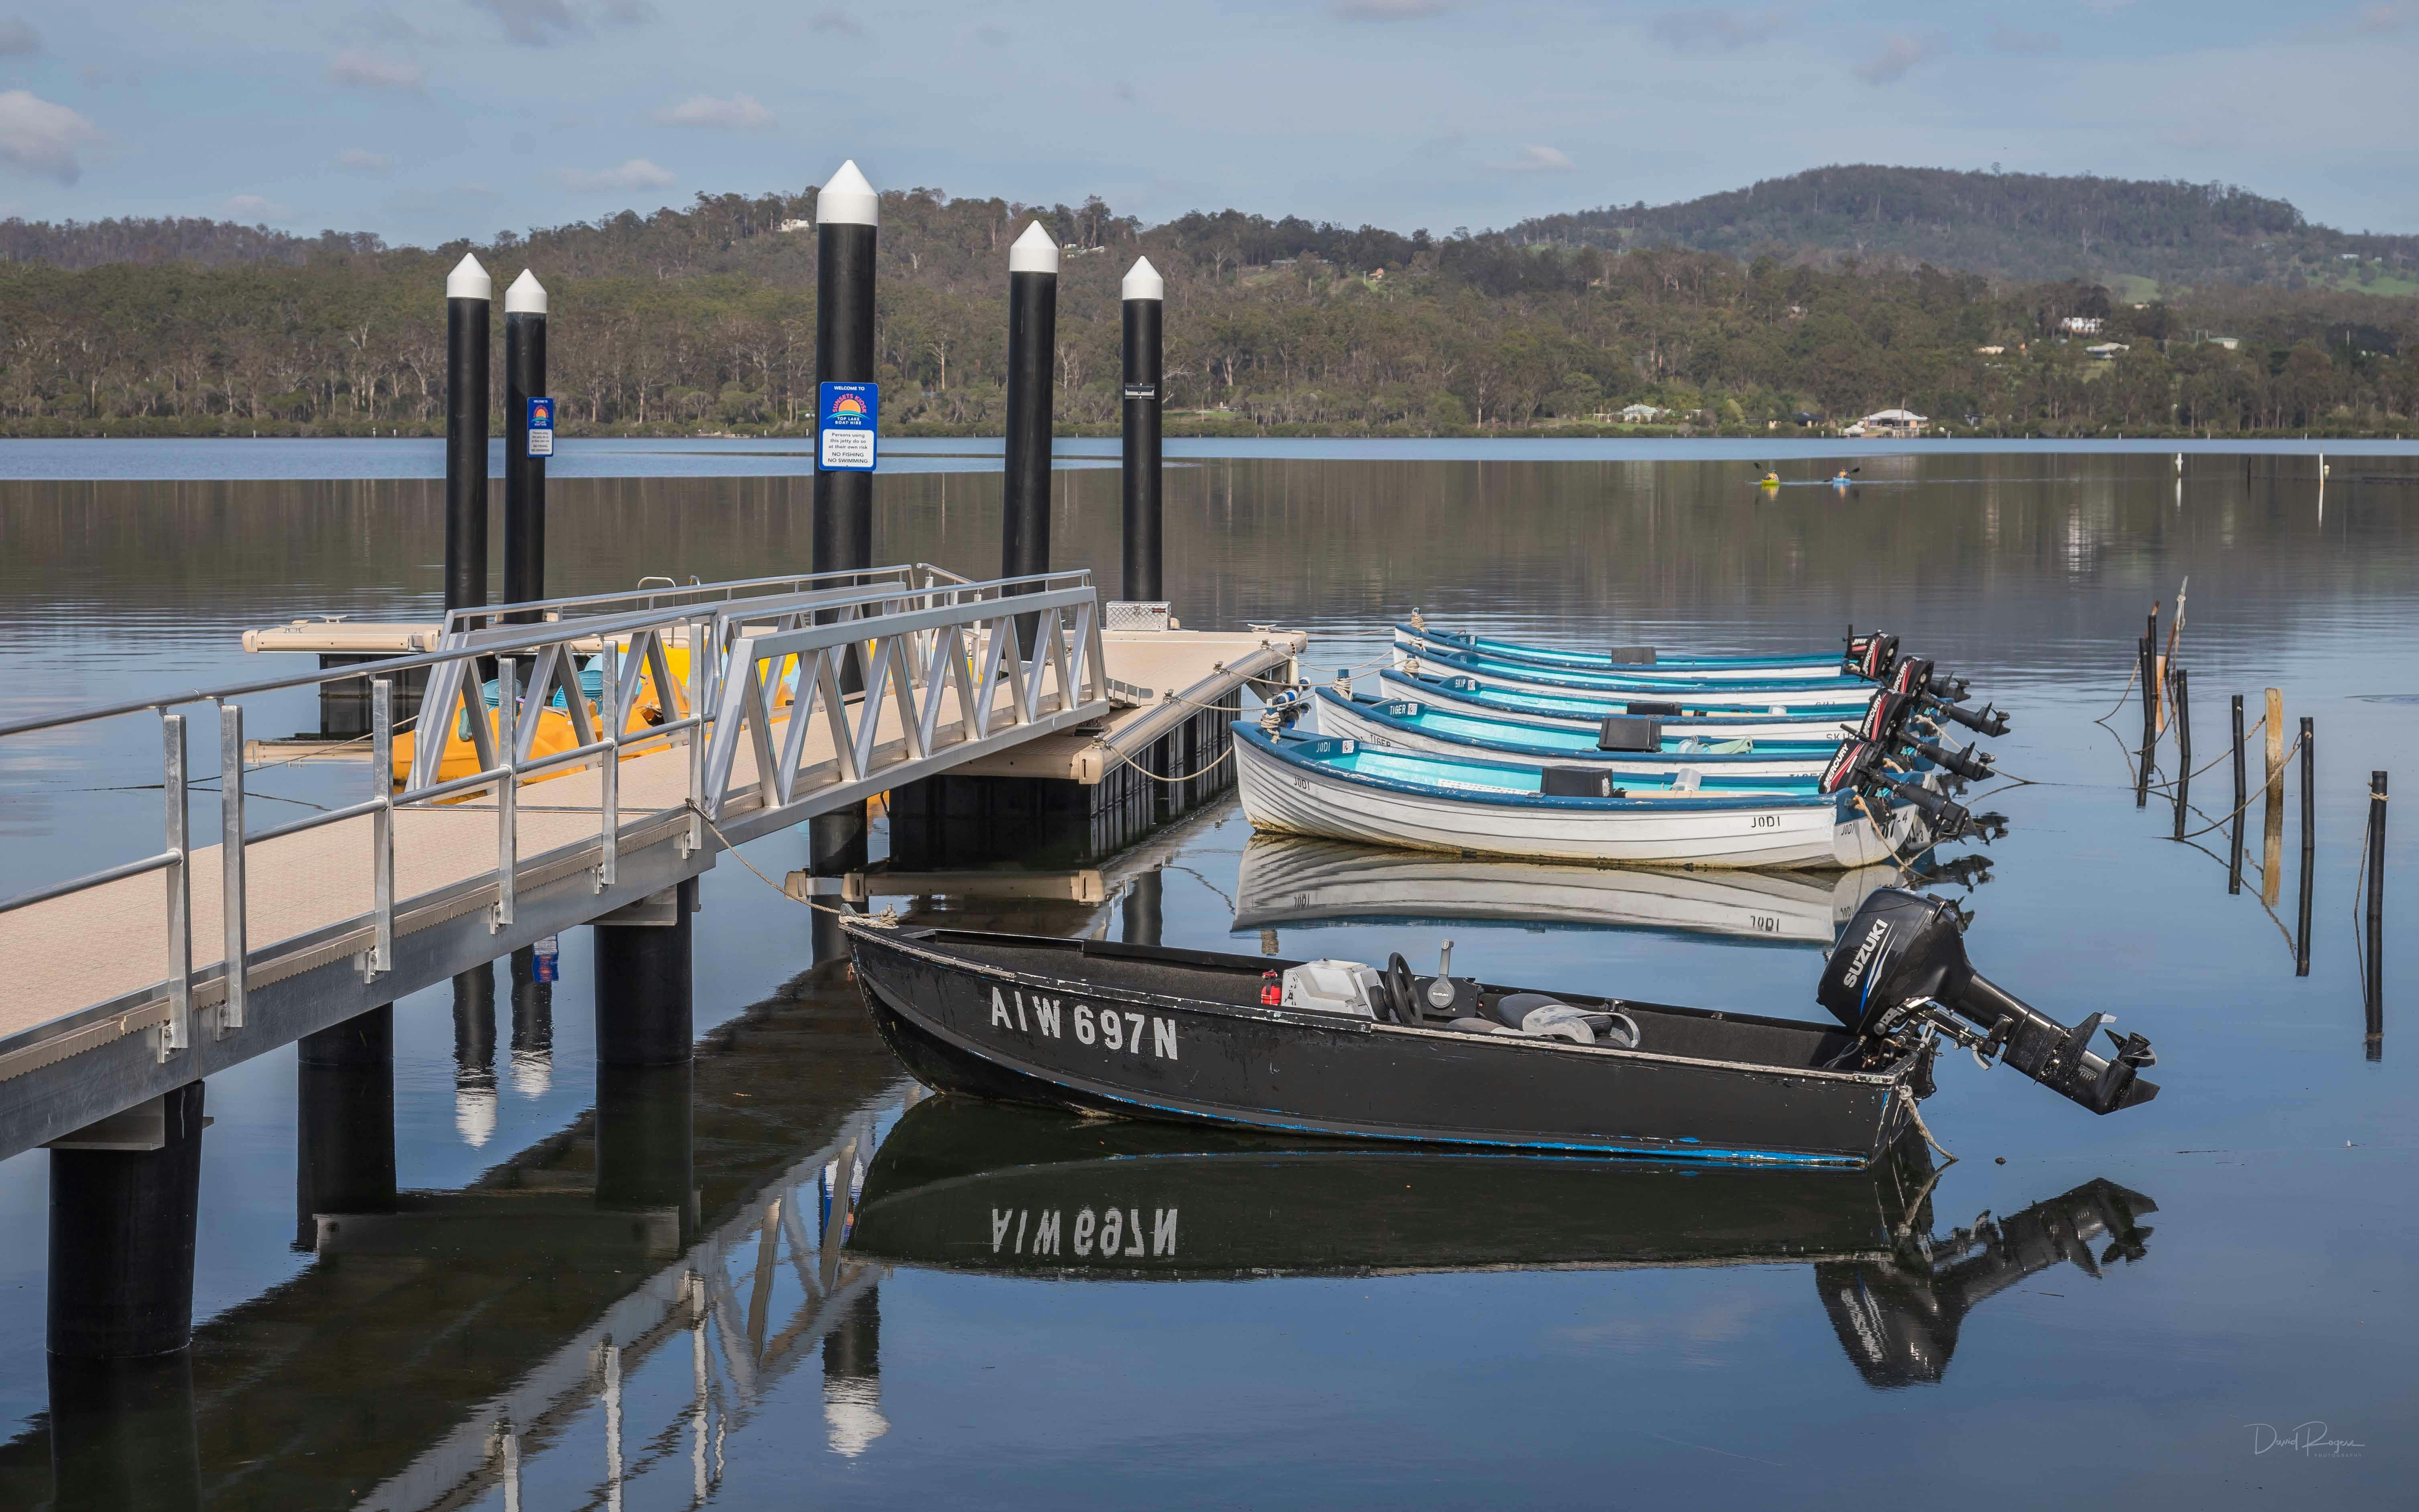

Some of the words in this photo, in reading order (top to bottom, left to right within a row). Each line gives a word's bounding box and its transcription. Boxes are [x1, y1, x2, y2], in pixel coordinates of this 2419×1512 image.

[832, 393, 854, 413] SUNSETS
[854, 395, 867, 413] KIOSK
[1455, 679, 1466, 688] SKIP
[1893, 661, 1907, 692] ERCURY
[1390, 704, 1406, 715] TIGER
[1862, 694, 1882, 737] MERCURY
[1316, 741, 1331, 753] JODI
[1823, 743, 1849, 793] MERCURY
[1294, 776, 1310, 791] JODI
[1751, 816, 1780, 828] JODI
[1841, 823, 1855, 836] JODI
[1843, 918, 1888, 988] SUZUKI
[992, 987, 1061, 1038] AIW
[1074, 1005, 1178, 1060] 697N
